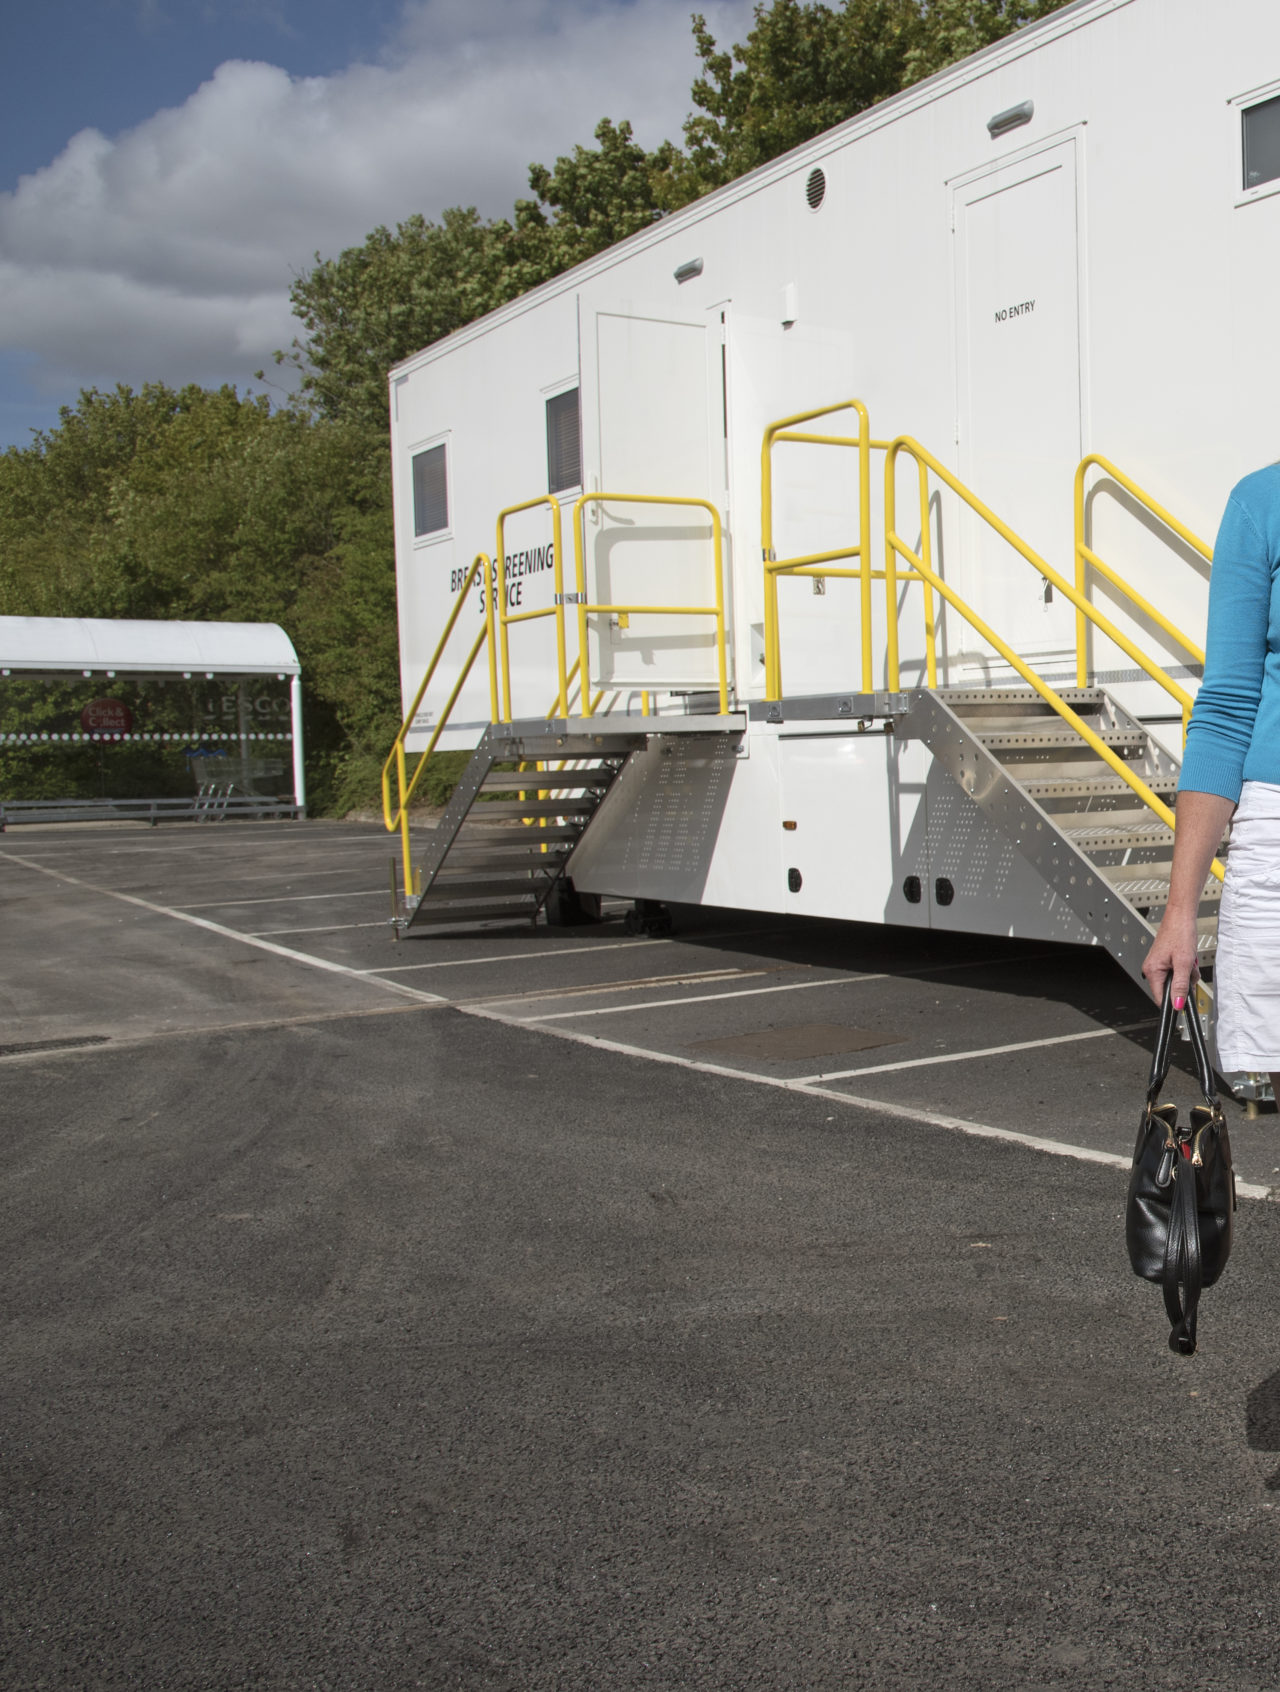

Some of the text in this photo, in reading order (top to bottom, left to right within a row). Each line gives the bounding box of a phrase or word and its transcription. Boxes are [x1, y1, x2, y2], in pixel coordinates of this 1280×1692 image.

[994, 300, 1036, 323] NO ENTRY
[491, 542, 554, 582] SREENING
[479, 581, 522, 613] SRICE
[88, 706, 125, 717] Click &
